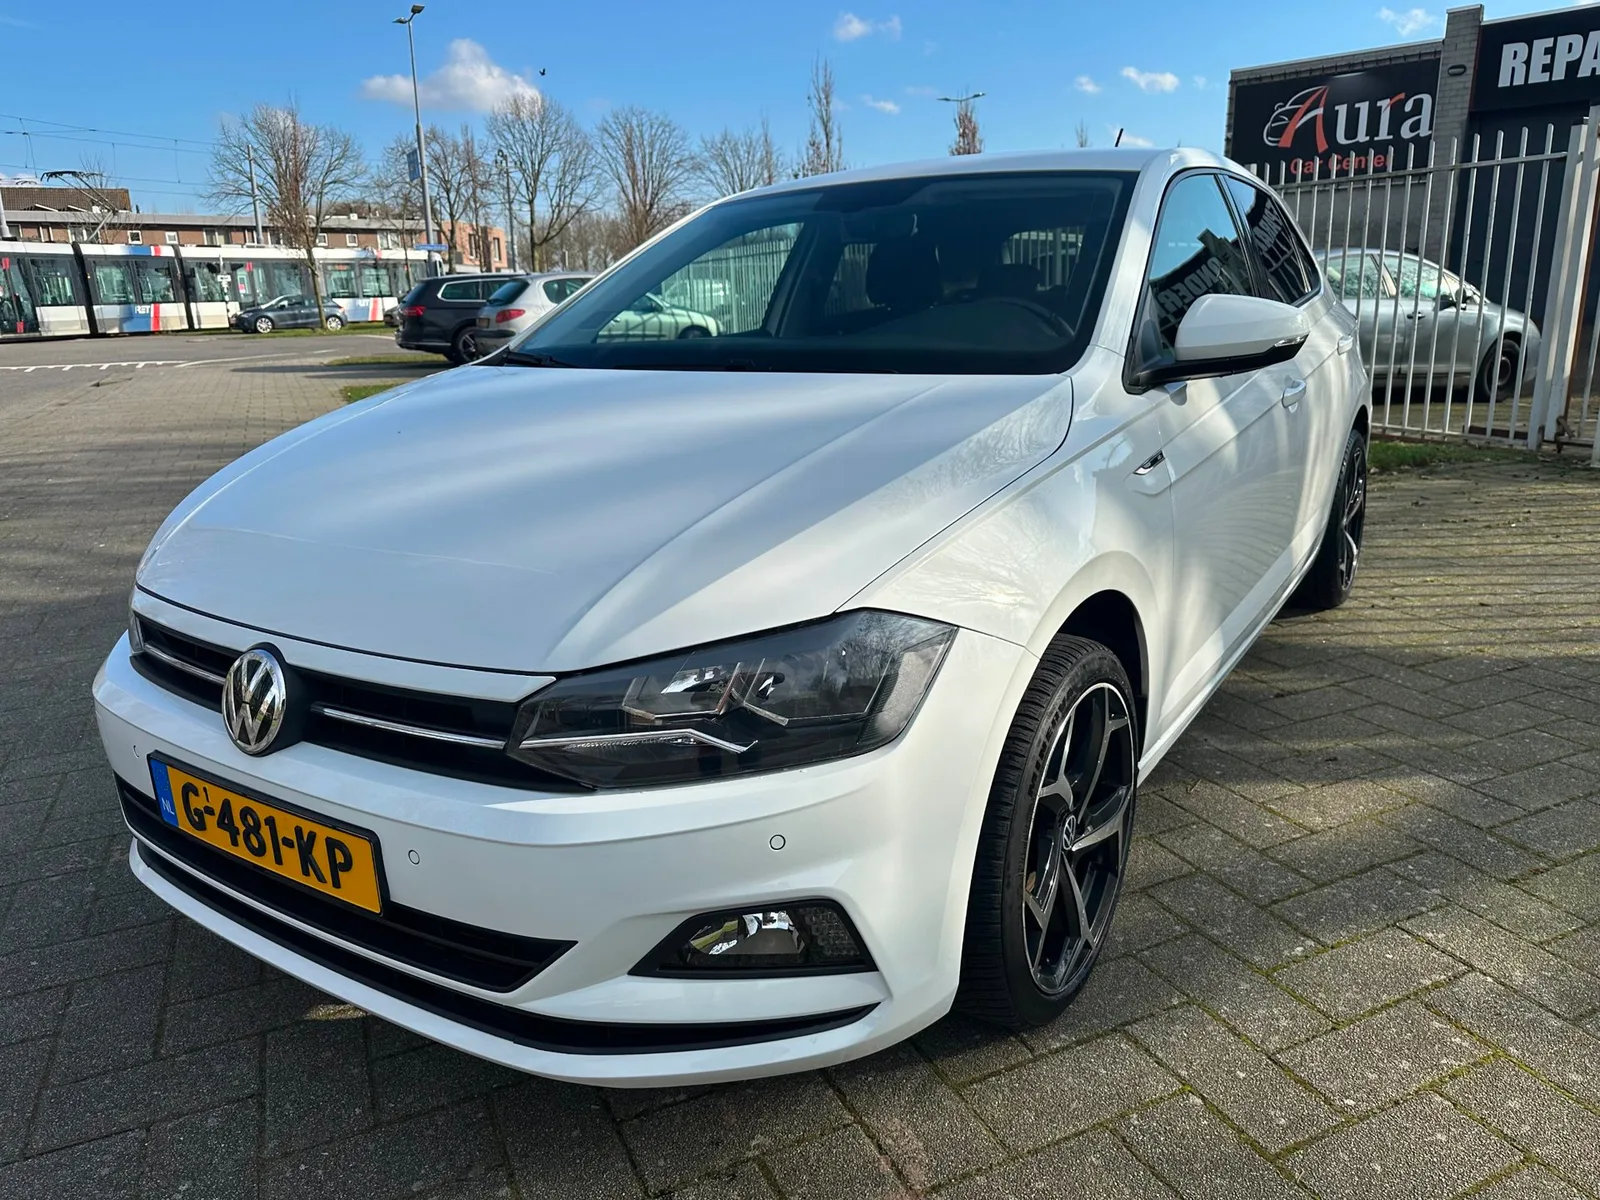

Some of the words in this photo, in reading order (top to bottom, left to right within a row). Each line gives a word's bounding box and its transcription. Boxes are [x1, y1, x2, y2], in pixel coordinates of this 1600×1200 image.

[1497, 30, 1600, 88] REPA
[1276, 85, 1433, 153] Aura
[160, 797, 175, 815] NL
[181, 781, 354, 889] G-481-KP
